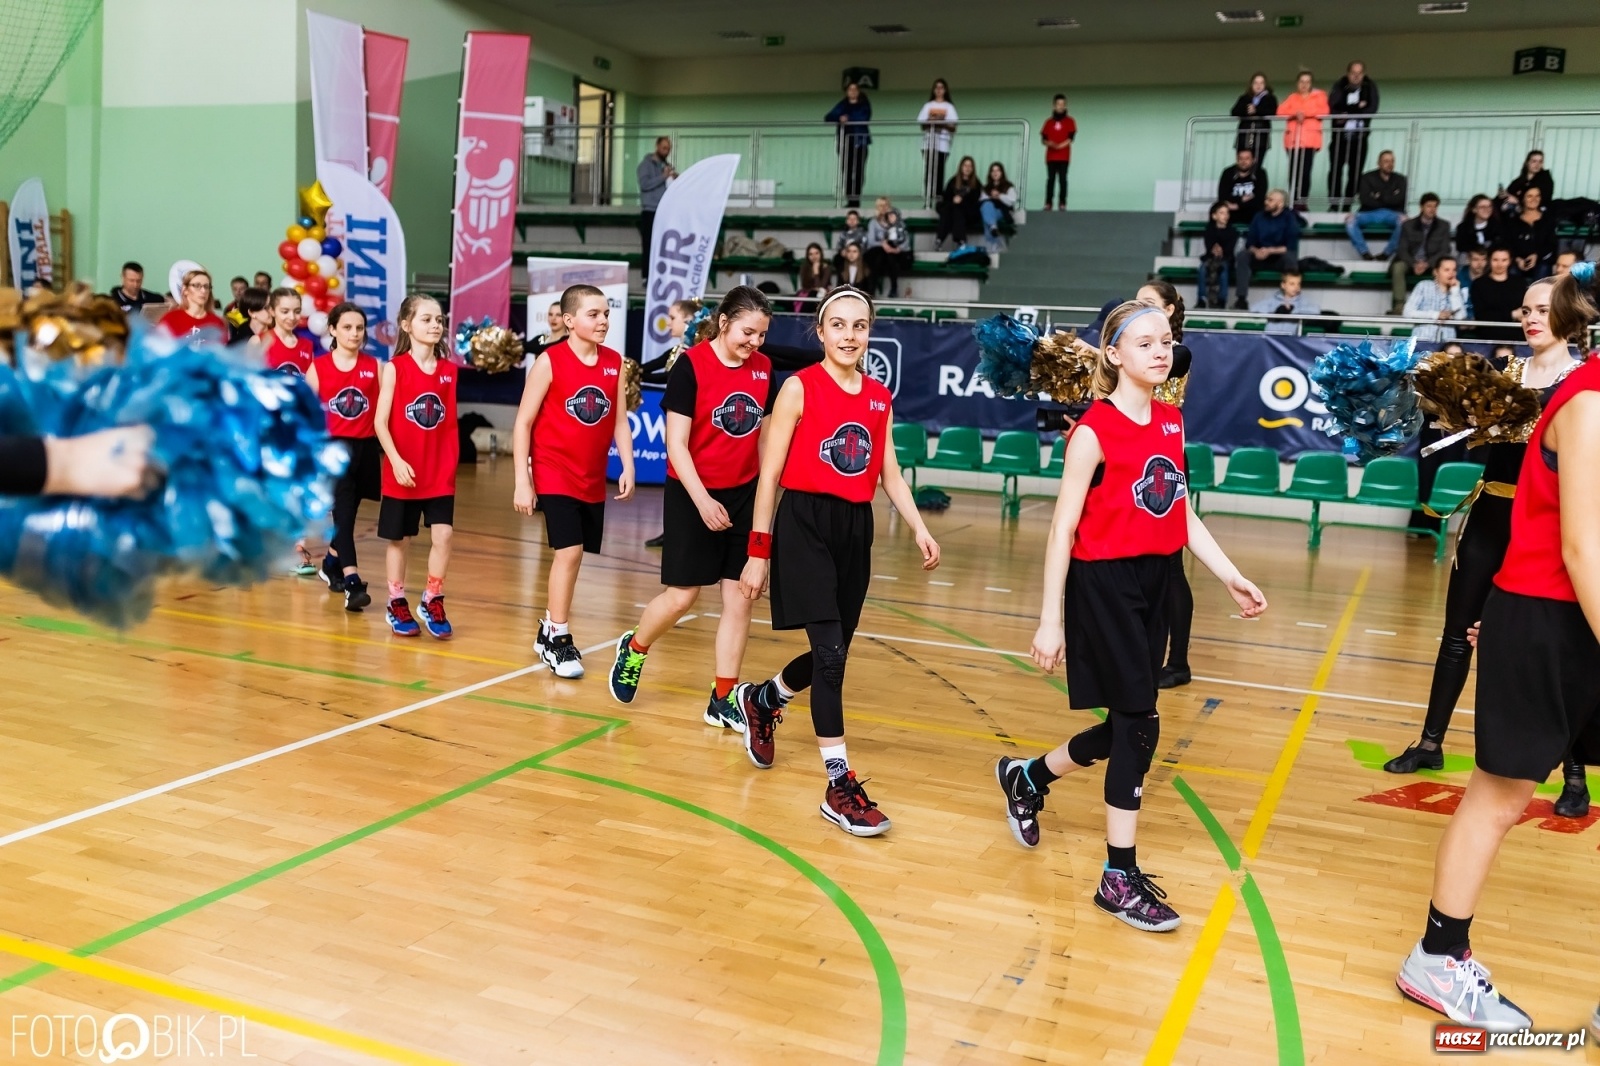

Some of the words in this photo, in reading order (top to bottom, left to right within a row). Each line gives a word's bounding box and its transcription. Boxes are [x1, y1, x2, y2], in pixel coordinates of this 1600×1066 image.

[1519, 57, 1535, 71] B
[1545, 56, 1560, 70] B
[858, 75, 874, 87] A
[15, 217, 37, 291] INI
[33, 219, 52, 279] TBALL
[688, 234, 711, 300] ACIBÓRZ
[567, 397, 587, 406] HOUSTON
[715, 405, 736, 417] HOUSTON
[823, 438, 846, 450] HOUSTON
[641, 449, 660, 461] App
[1136, 474, 1155, 494] HOUSTON
[1164, 471, 1185, 484] ROCKETS
